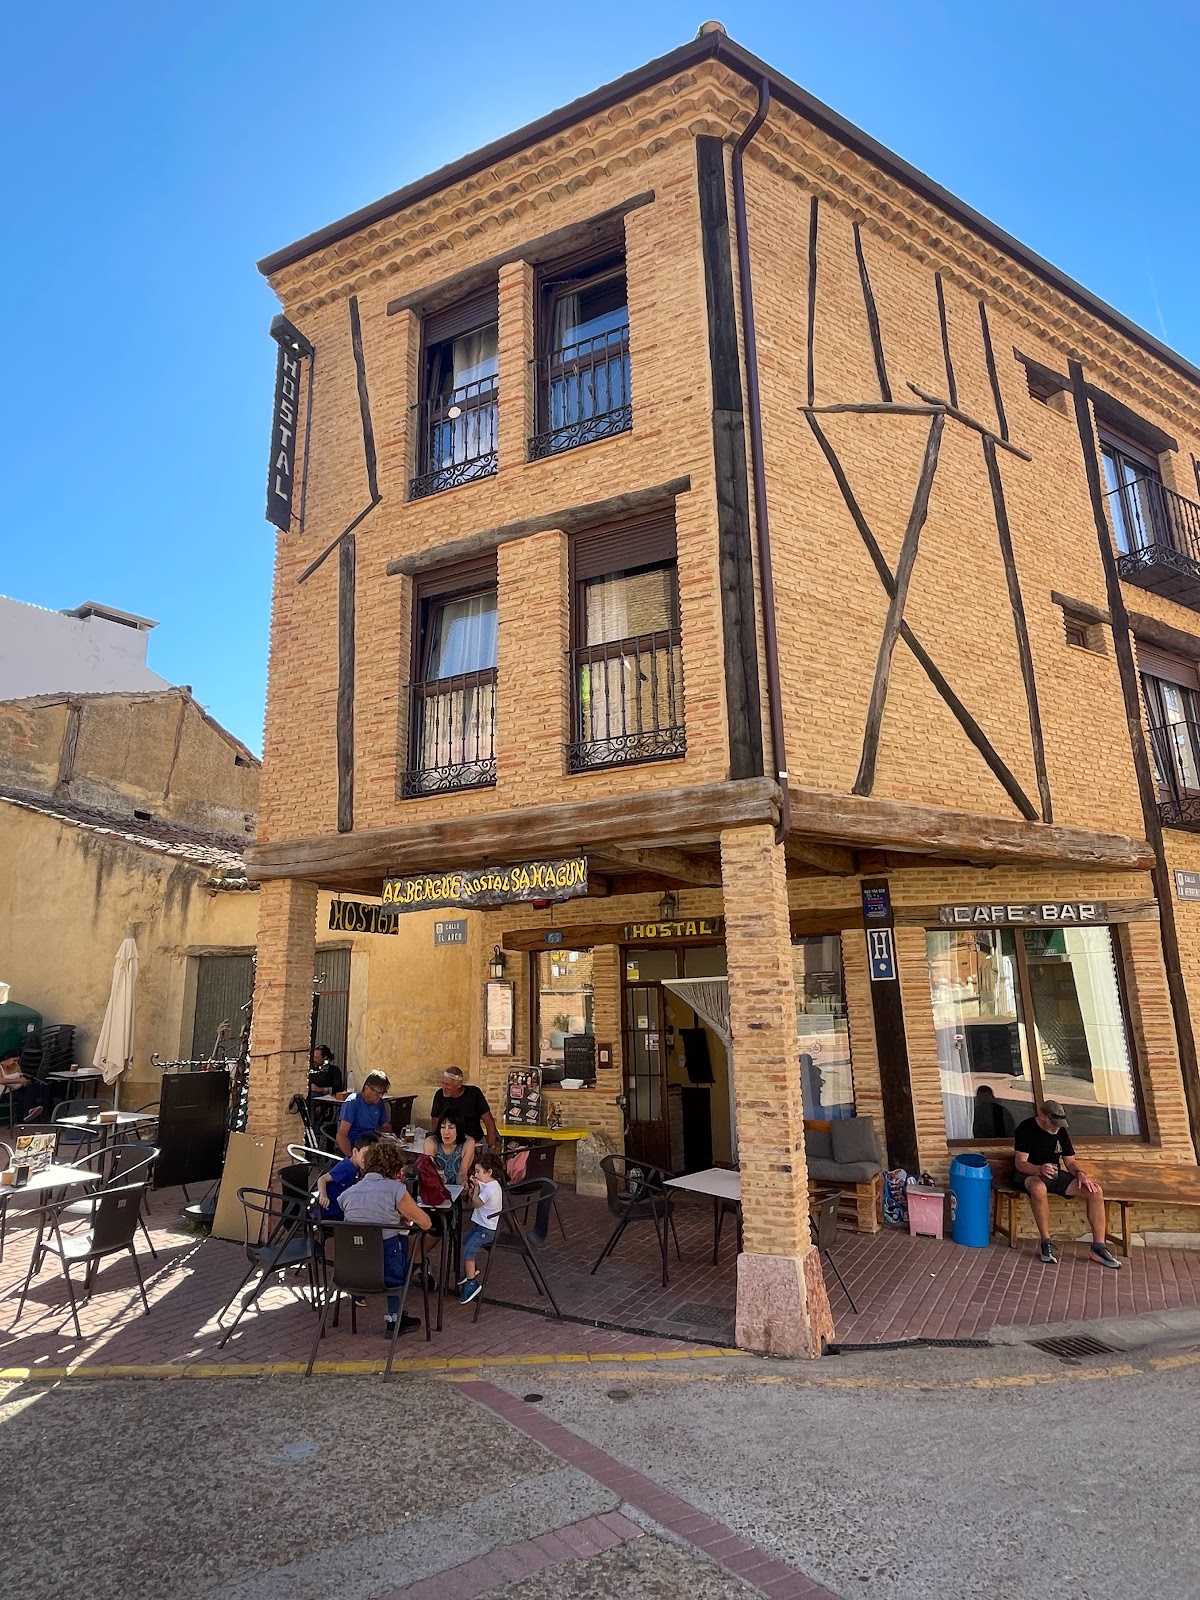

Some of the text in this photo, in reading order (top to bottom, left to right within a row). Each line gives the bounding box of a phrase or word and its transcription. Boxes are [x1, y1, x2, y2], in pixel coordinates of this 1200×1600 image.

[274, 352, 298, 502] HOSTAL
[382, 859, 586, 905] ALBERGUE HOSTAL SAHAGUN
[330, 899, 399, 934] HOSTAL
[953, 905, 1024, 923] CAFE
[1042, 904, 1095, 921] BAR
[438, 932, 462, 942] EL ARCO
[445, 922, 460, 931] CALLE
[632, 920, 712, 938] HOSTAL
[871, 932, 889, 960] H
